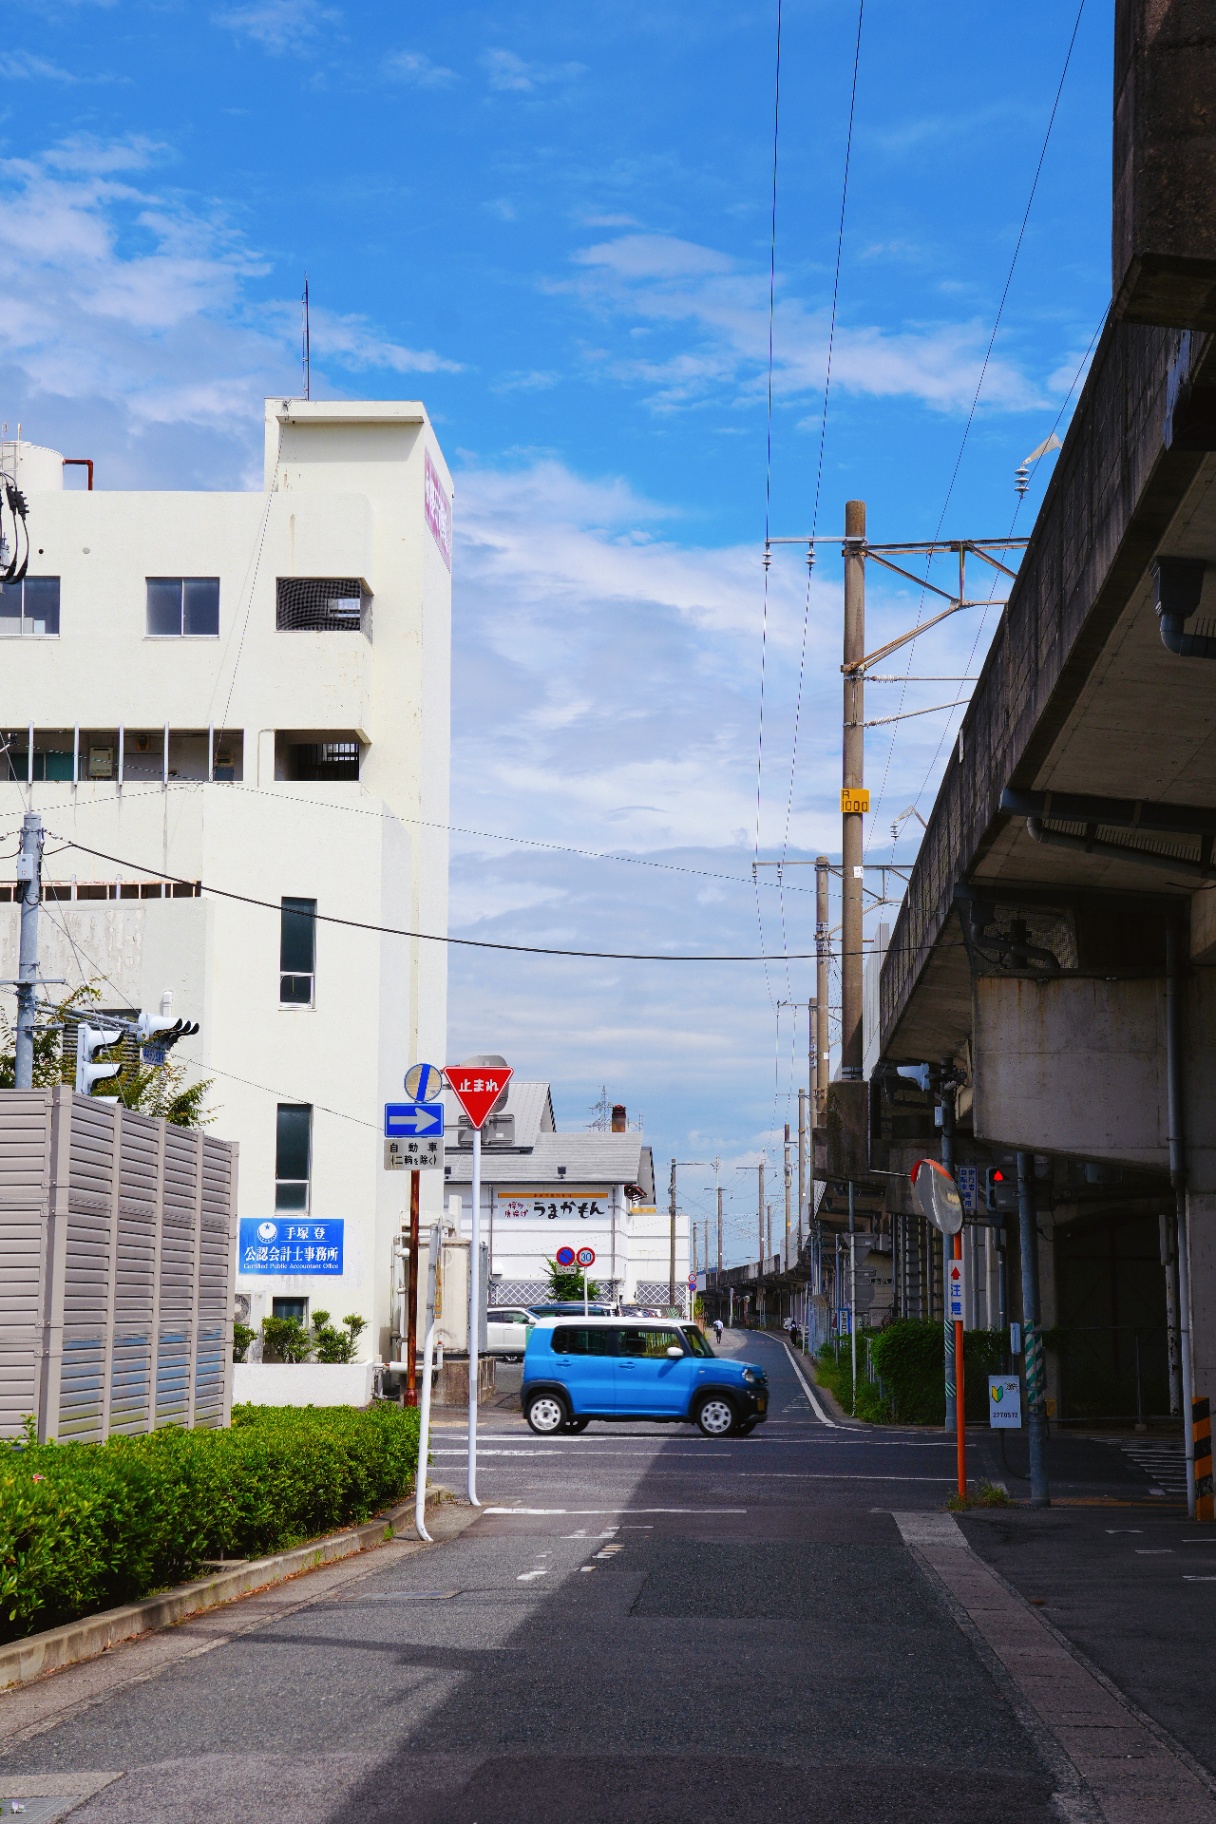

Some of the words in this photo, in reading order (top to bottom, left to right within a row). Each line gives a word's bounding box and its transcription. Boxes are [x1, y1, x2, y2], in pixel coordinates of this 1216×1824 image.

[842, 790, 850, 799] R
[842, 800, 868, 812] 1000
[459, 1079, 499, 1092] 止まれ
[389, 1142, 438, 1153] 自動車
[533, 1201, 605, 1219] うまかもん
[284, 1227, 309, 1240] 手塚
[313, 1227, 326, 1240] 登
[244, 1246, 339, 1262] 公認会計士事務所
[580, 1252, 592, 1262] 30
[950, 1284, 962, 1315] 注意
